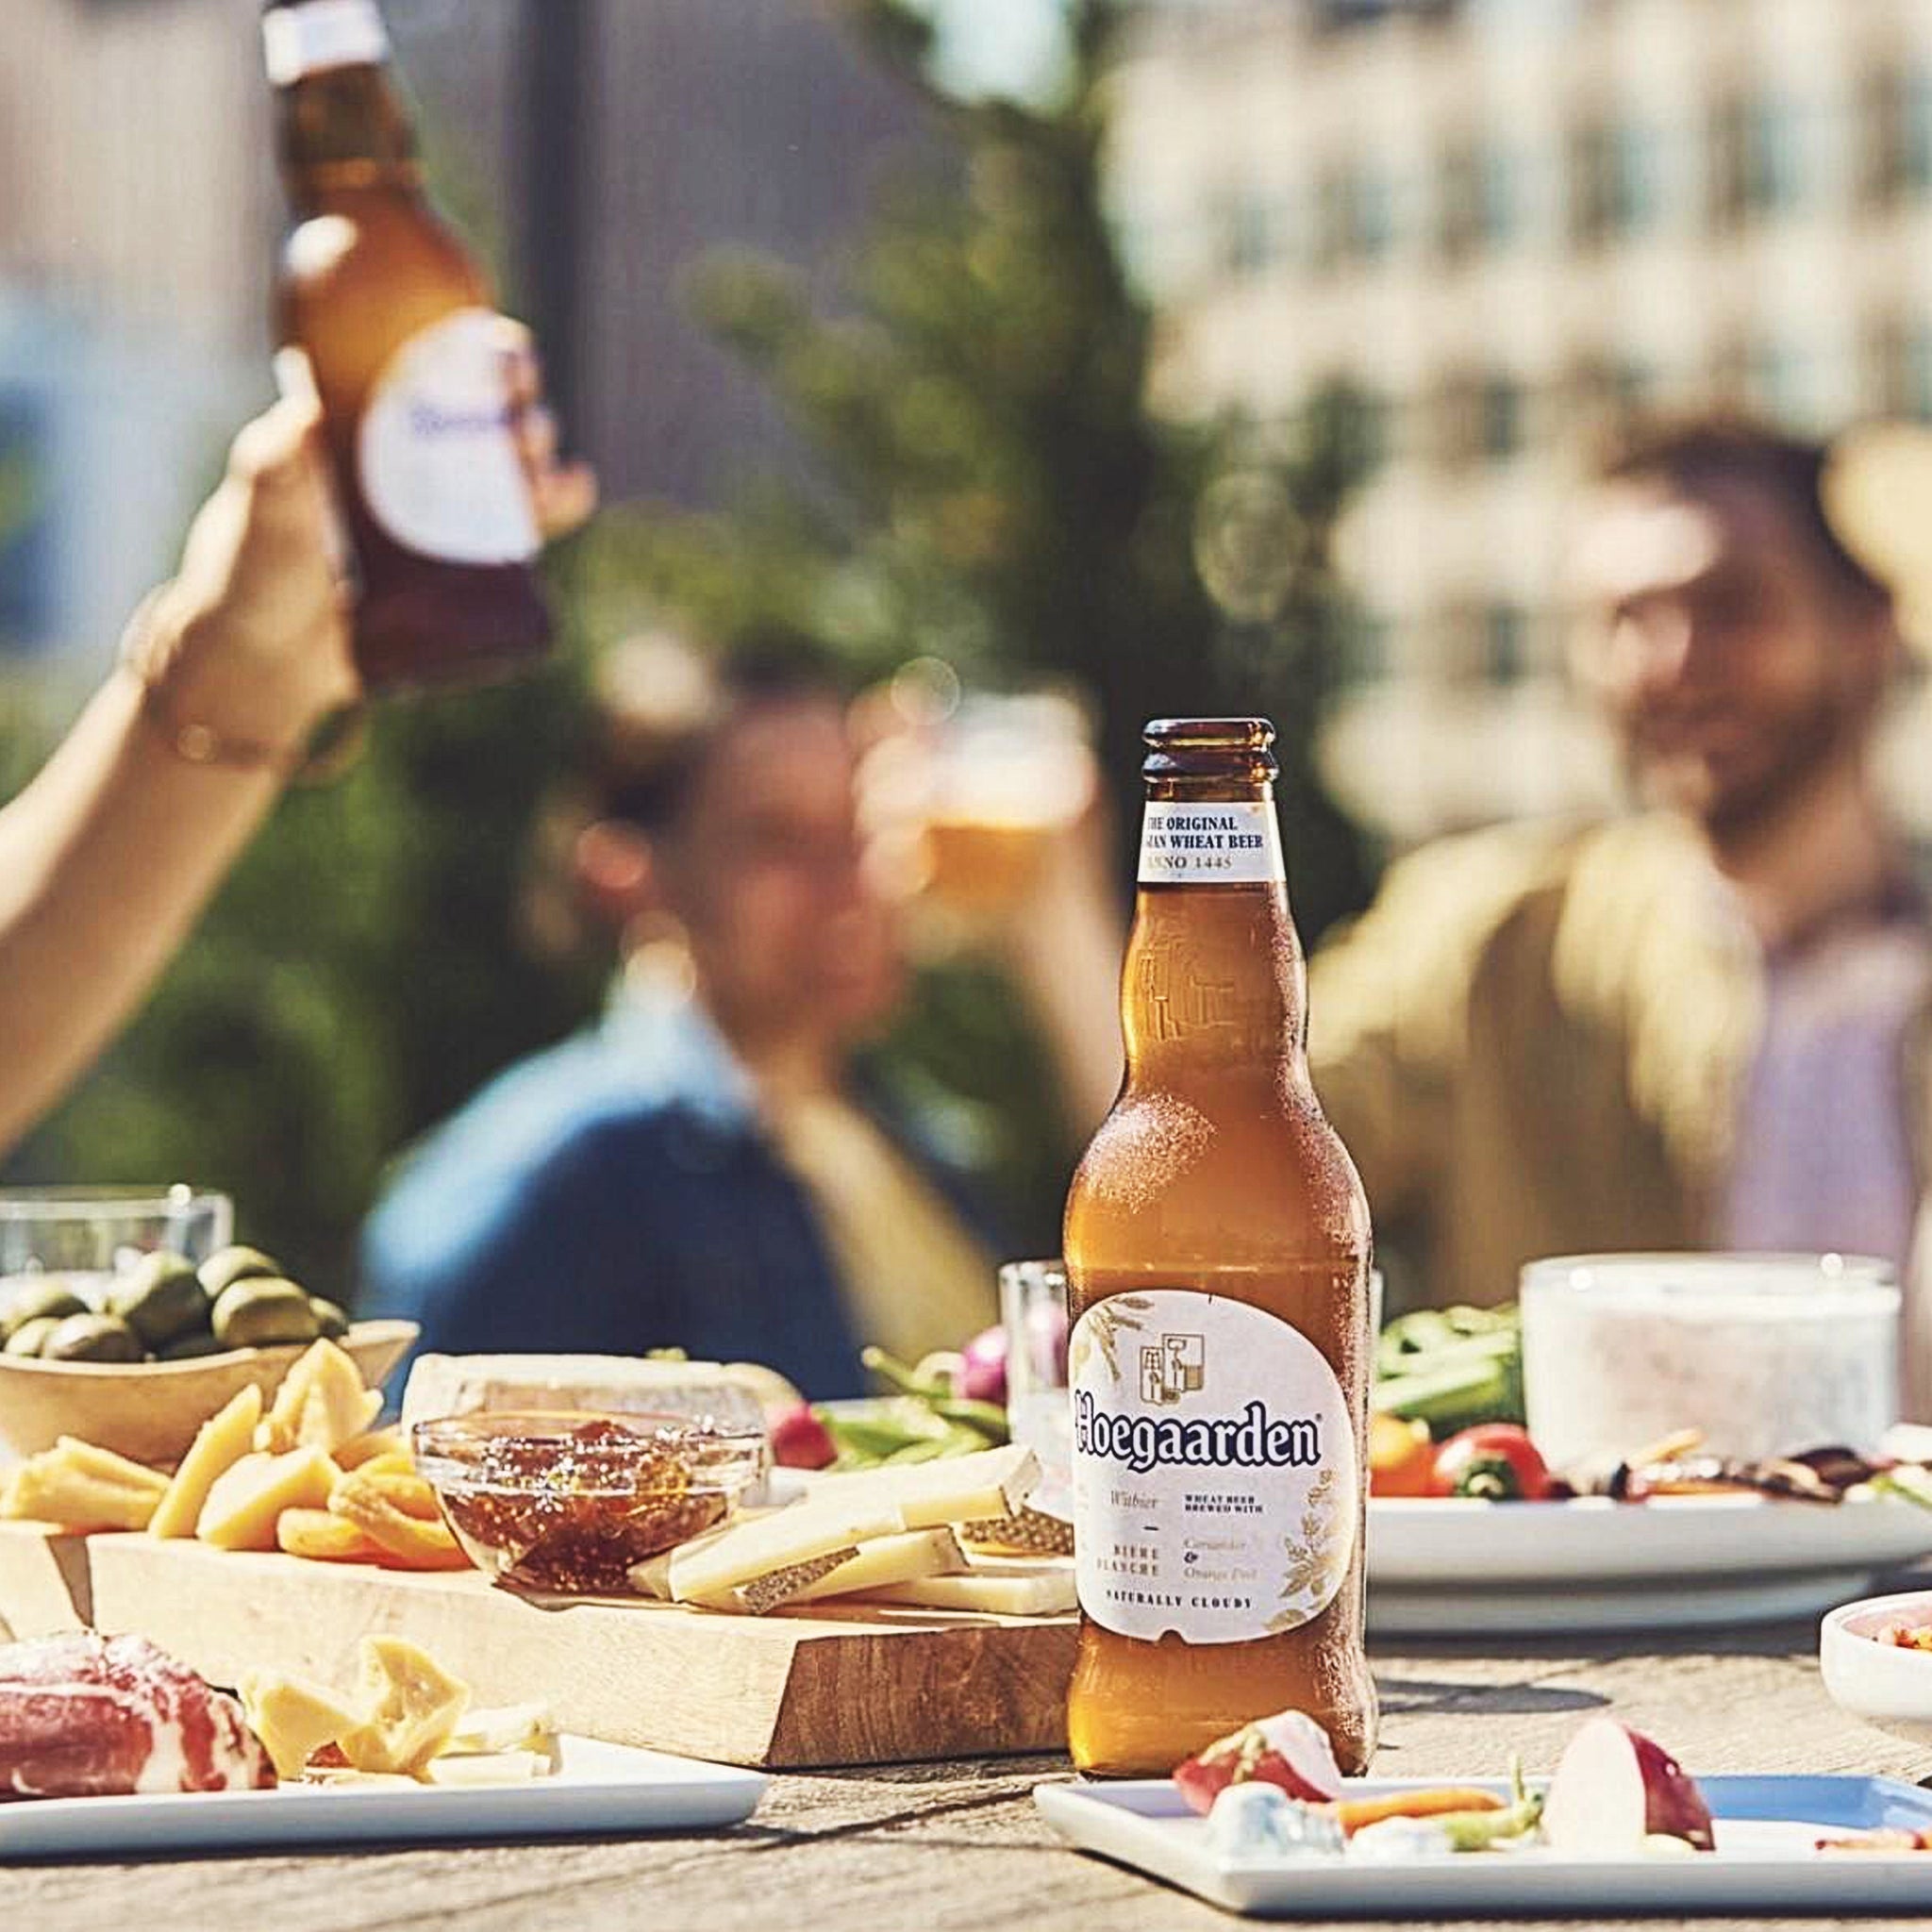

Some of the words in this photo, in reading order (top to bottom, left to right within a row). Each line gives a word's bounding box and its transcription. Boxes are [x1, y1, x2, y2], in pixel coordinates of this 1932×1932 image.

[1166, 817, 1238, 830] ORIGINAL
[1170, 835, 1224, 848] WHEAT
[1228, 835, 1263, 849] BEER
[1196, 856, 1232, 869] 1445
[1075, 1389, 1321, 1474] Hoegaarden
[1185, 1494, 1223, 1504] WHEAT
[1191, 1596, 1253, 1608] CLOUDY
